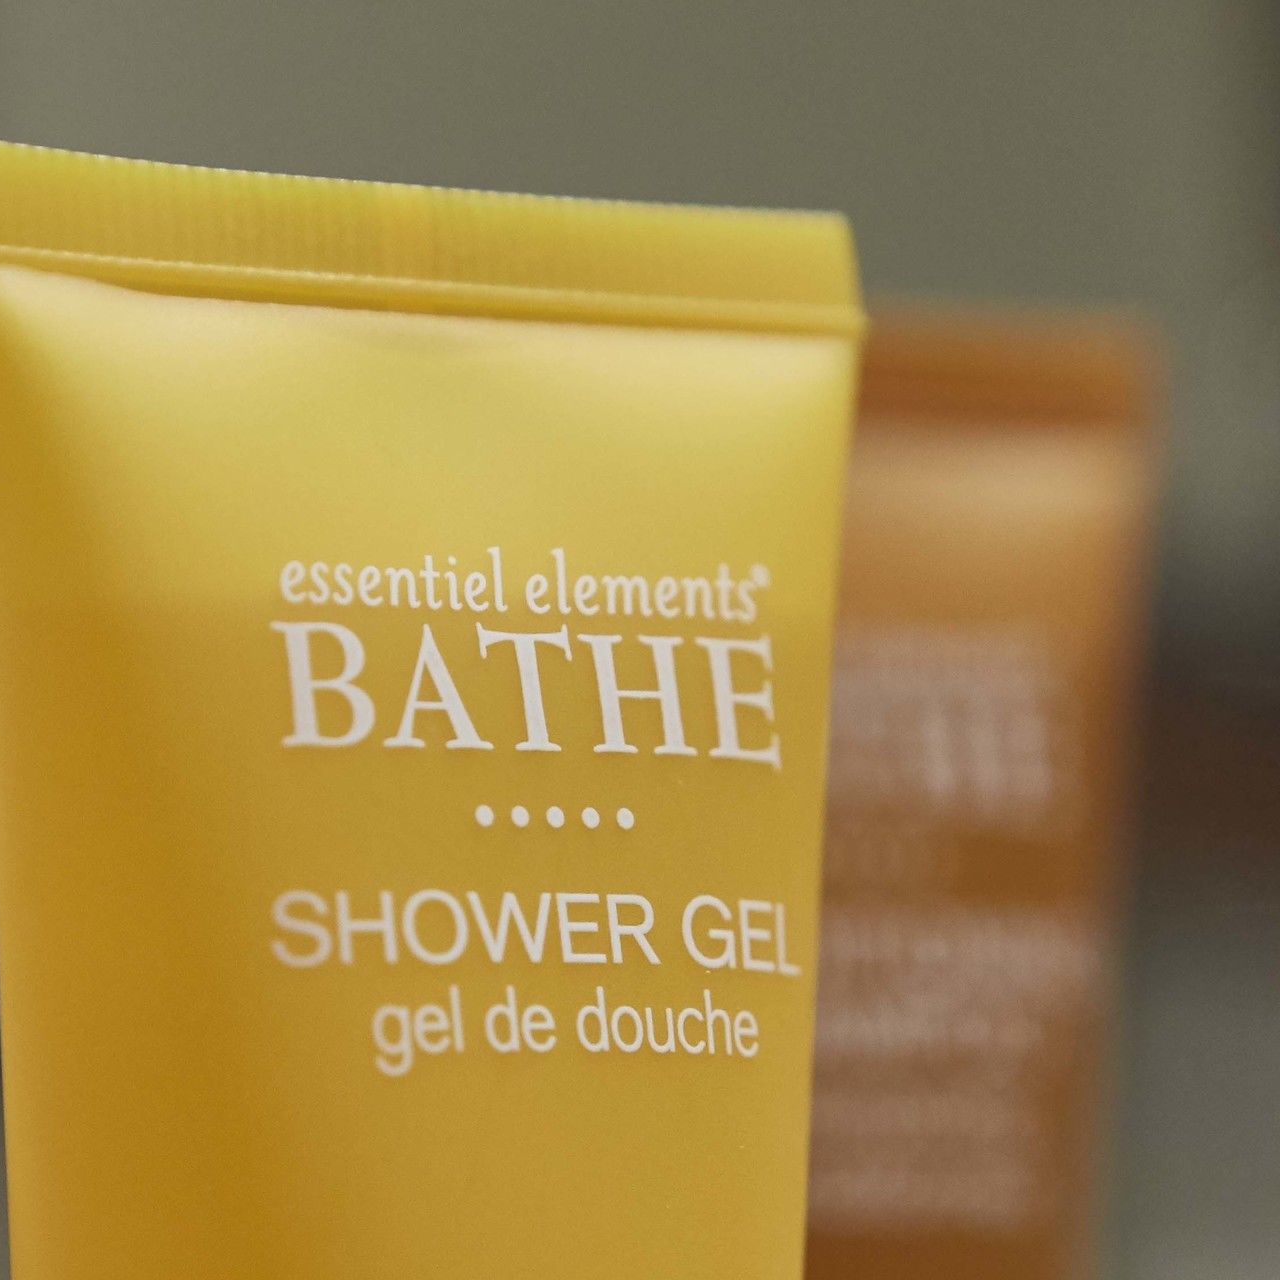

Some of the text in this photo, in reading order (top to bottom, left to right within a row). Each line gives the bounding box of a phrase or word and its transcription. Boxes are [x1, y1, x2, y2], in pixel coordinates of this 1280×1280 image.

[279, 546, 508, 612] essentiel
[270, 621, 782, 769] BATHE
[271, 889, 662, 969] SHOWER
[681, 895, 801, 977] GEL
[372, 984, 465, 1077] gel
[485, 985, 557, 1053] de
[576, 986, 760, 1058] douche
